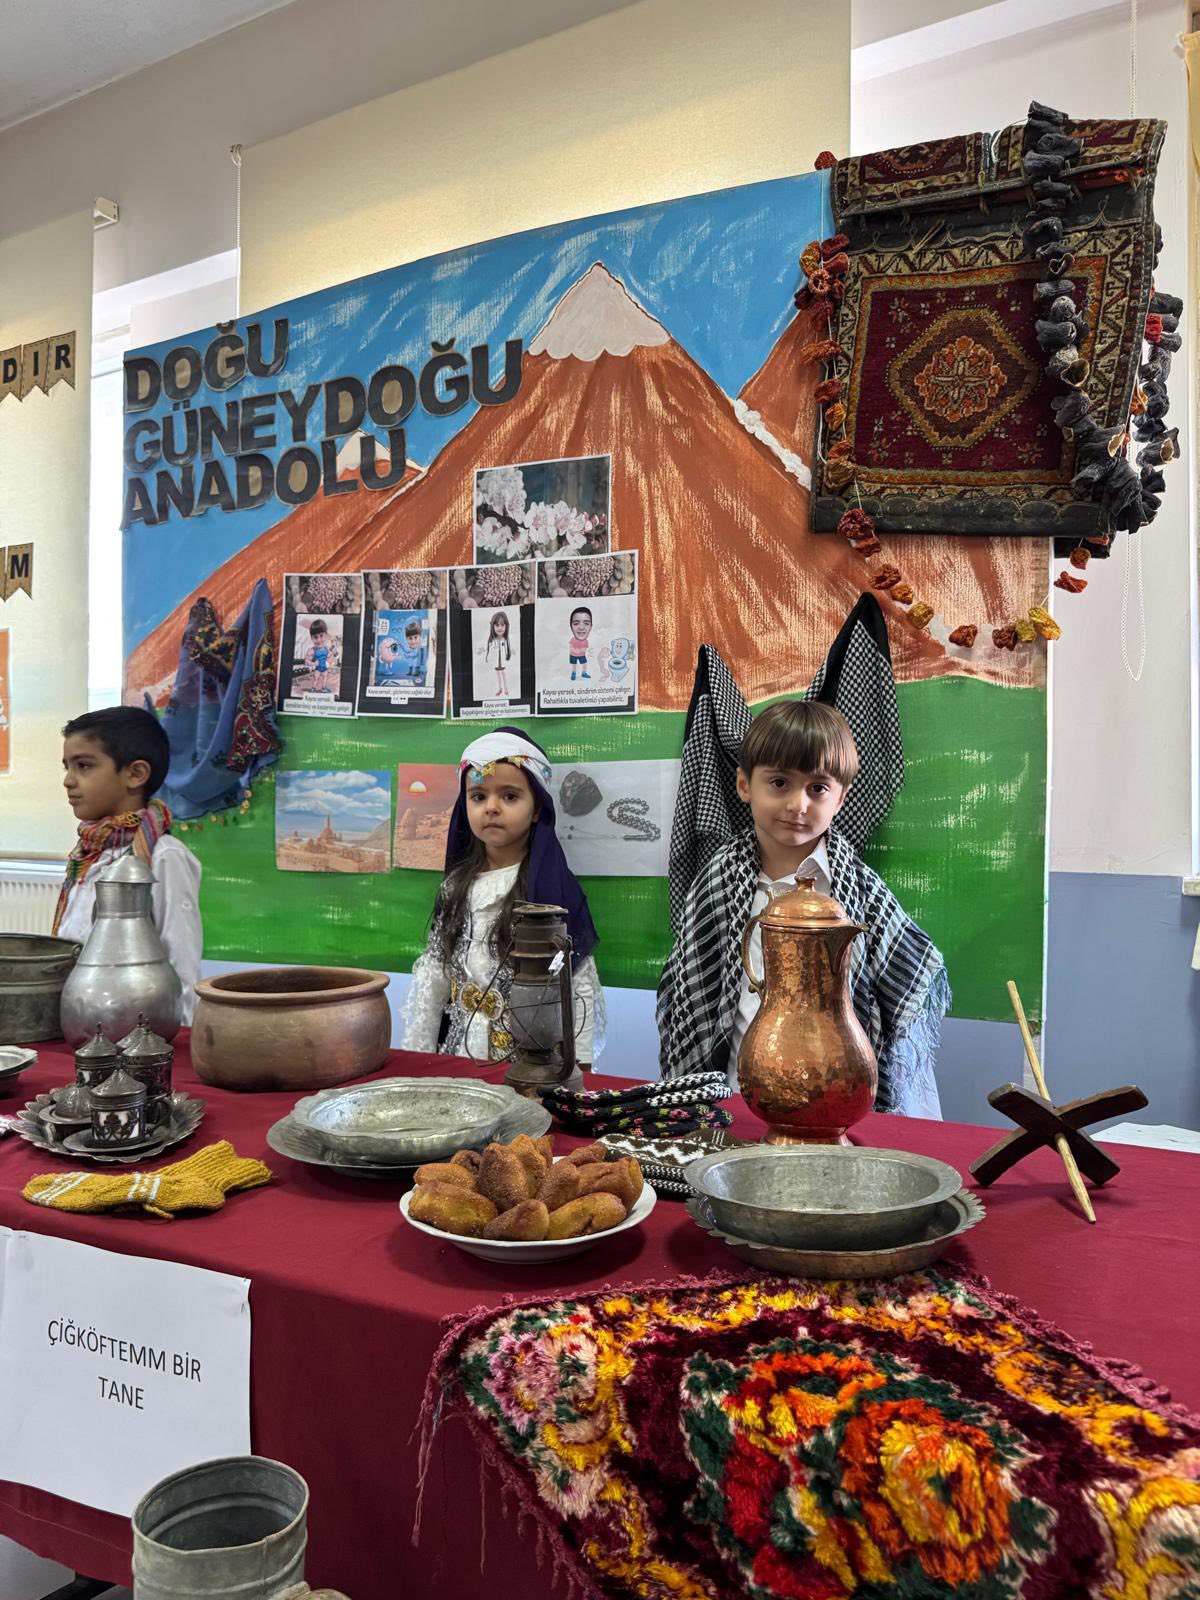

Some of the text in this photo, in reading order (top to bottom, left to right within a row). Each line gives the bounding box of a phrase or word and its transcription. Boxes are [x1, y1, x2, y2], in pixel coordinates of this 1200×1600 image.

[123, 337, 524, 473] GÜNEYDOĞU
[124, 319, 289, 414] DOĞU
[121, 428, 407, 531] ANADOLU
[47, 1317, 202, 1383] ÇİĞKÖFTEMM BİR
[97, 1375, 145, 1410] TANE
